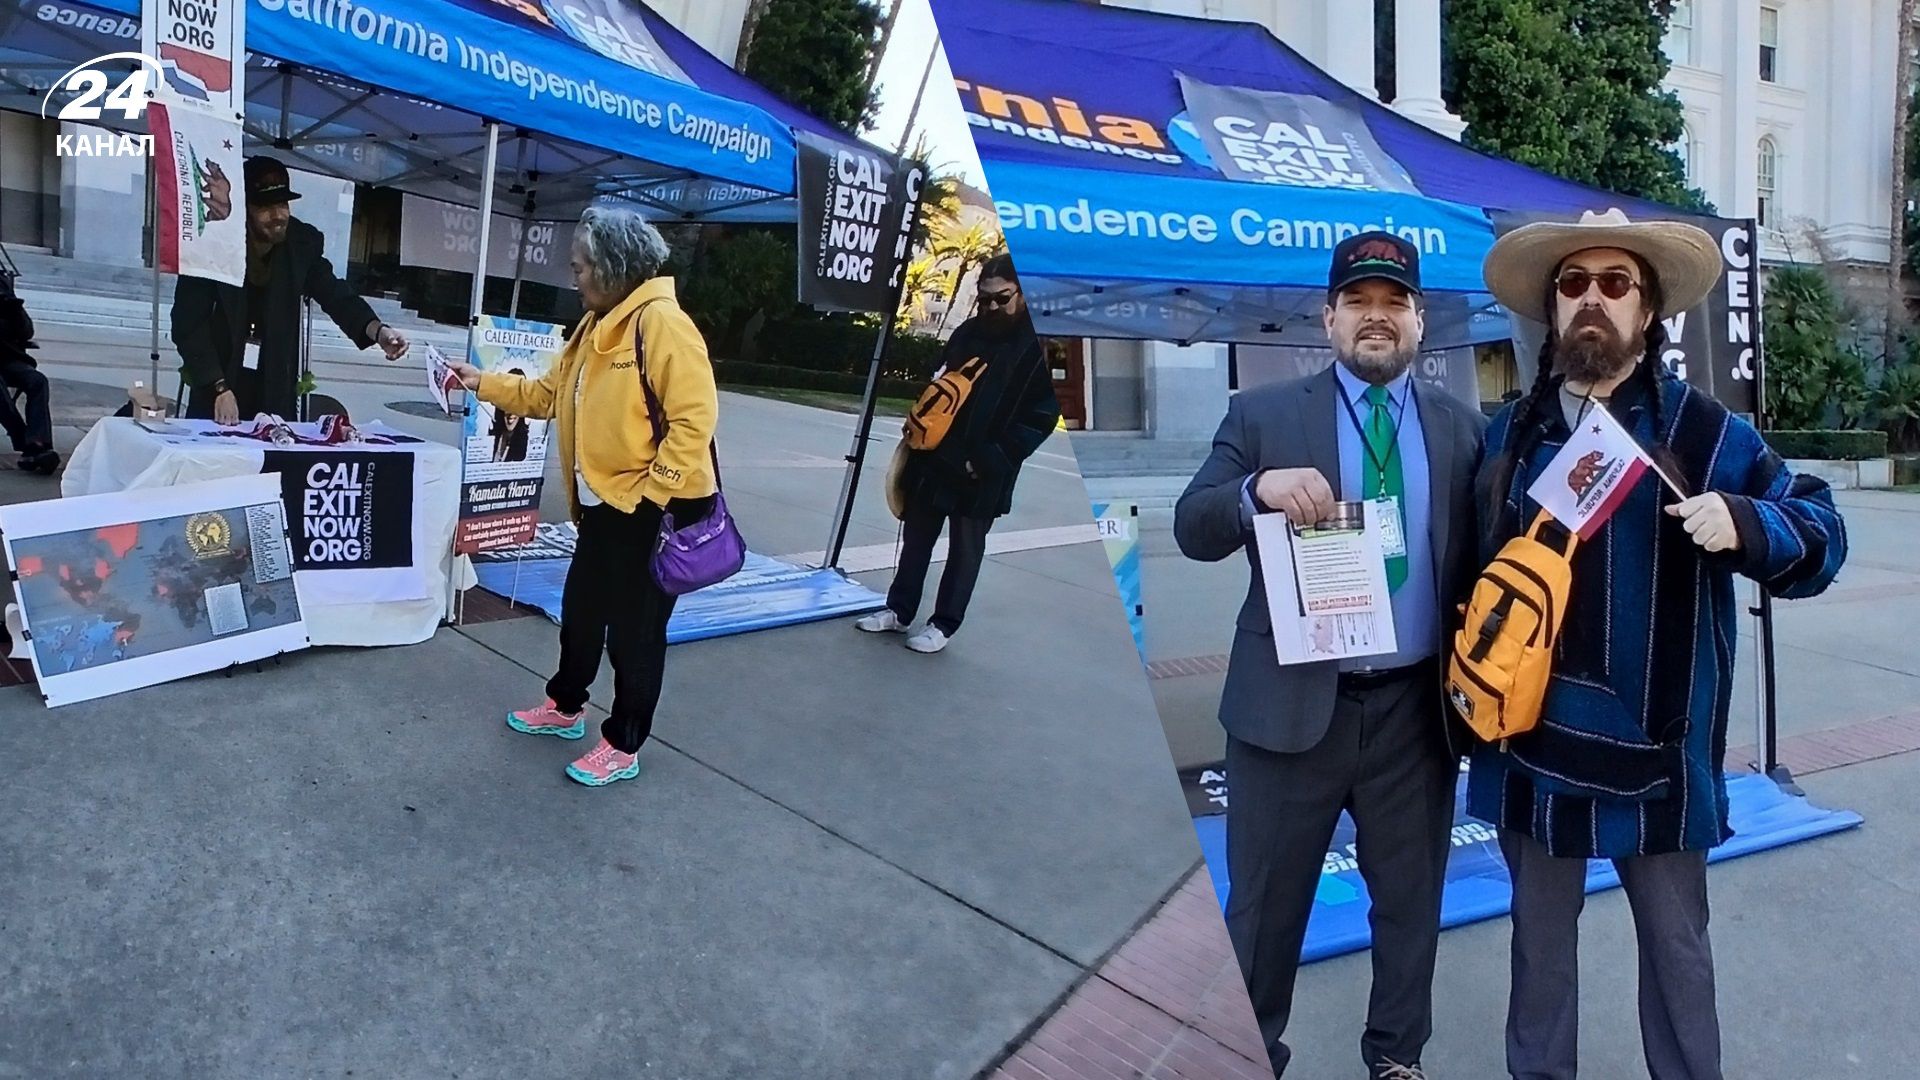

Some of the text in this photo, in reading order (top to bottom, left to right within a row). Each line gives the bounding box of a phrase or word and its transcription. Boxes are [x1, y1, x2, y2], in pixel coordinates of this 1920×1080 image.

[168, 0, 217, 28] NOW
[563, 5, 649, 52] CAL
[168, 22, 215, 50] .ORG
[455, 36, 662, 128] Independence
[667, 103, 771, 164] Campaign
[1213, 116, 1350, 152] CAL
[1221, 137, 1352, 171] EXIT
[1233, 157, 1365, 184] NOW
[174, 130, 193, 242] CALIFORNIA REPUBLIC
[836, 150, 888, 194] CAL
[834, 184, 887, 225] EXIT
[994, 199, 1217, 241] endence
[829, 219, 881, 253] NOW
[827, 252, 874, 284] .ORG
[484, 329, 555, 349] CALEXIT BACKER
[306, 462, 362, 489] CAL
[468, 481, 537, 502] Kamala Harris
[303, 488, 362, 516] EXIT
[363, 462, 376, 560] CALEXITNOW.ORG
[303, 516, 361, 538] NOW
[303, 538, 362, 562] .ORG
